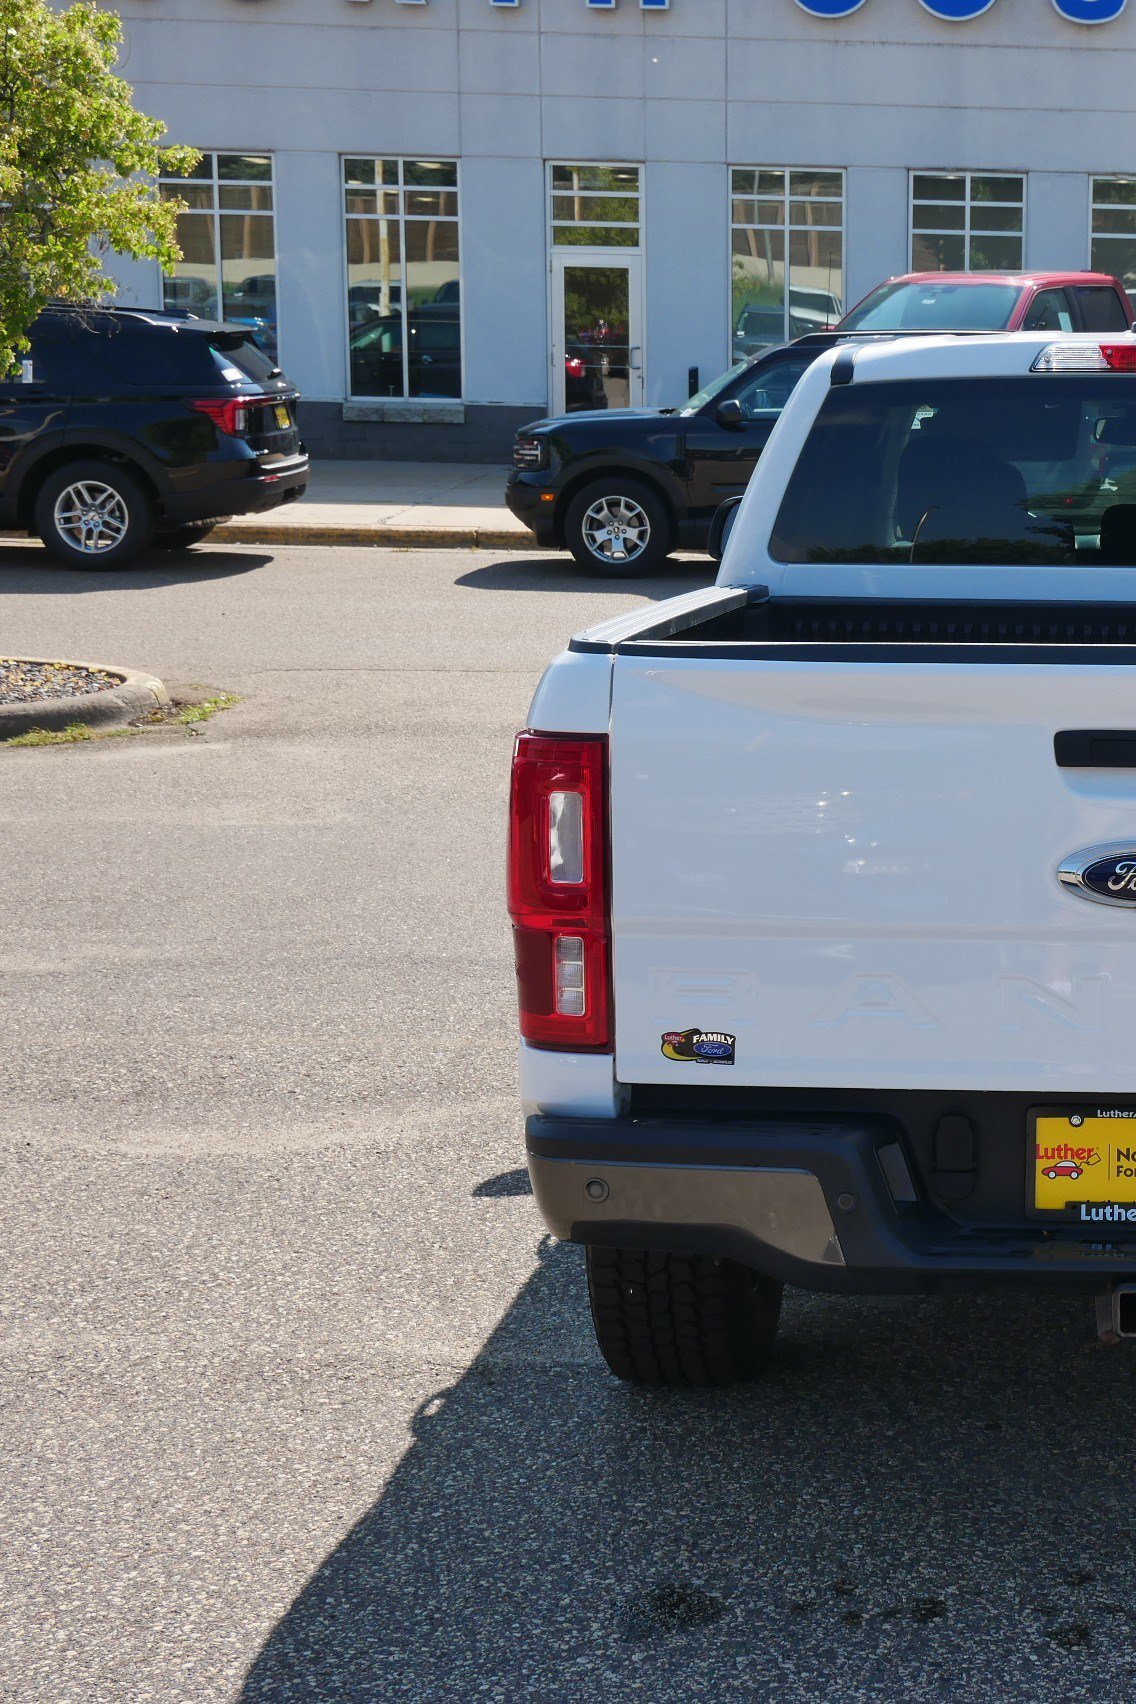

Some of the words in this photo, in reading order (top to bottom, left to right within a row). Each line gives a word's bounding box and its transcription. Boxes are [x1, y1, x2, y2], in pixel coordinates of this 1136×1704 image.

[692, 1033, 735, 1045] FAMILY
[700, 1044, 724, 1055] Ford
[1035, 1143, 1095, 1161] Luther
